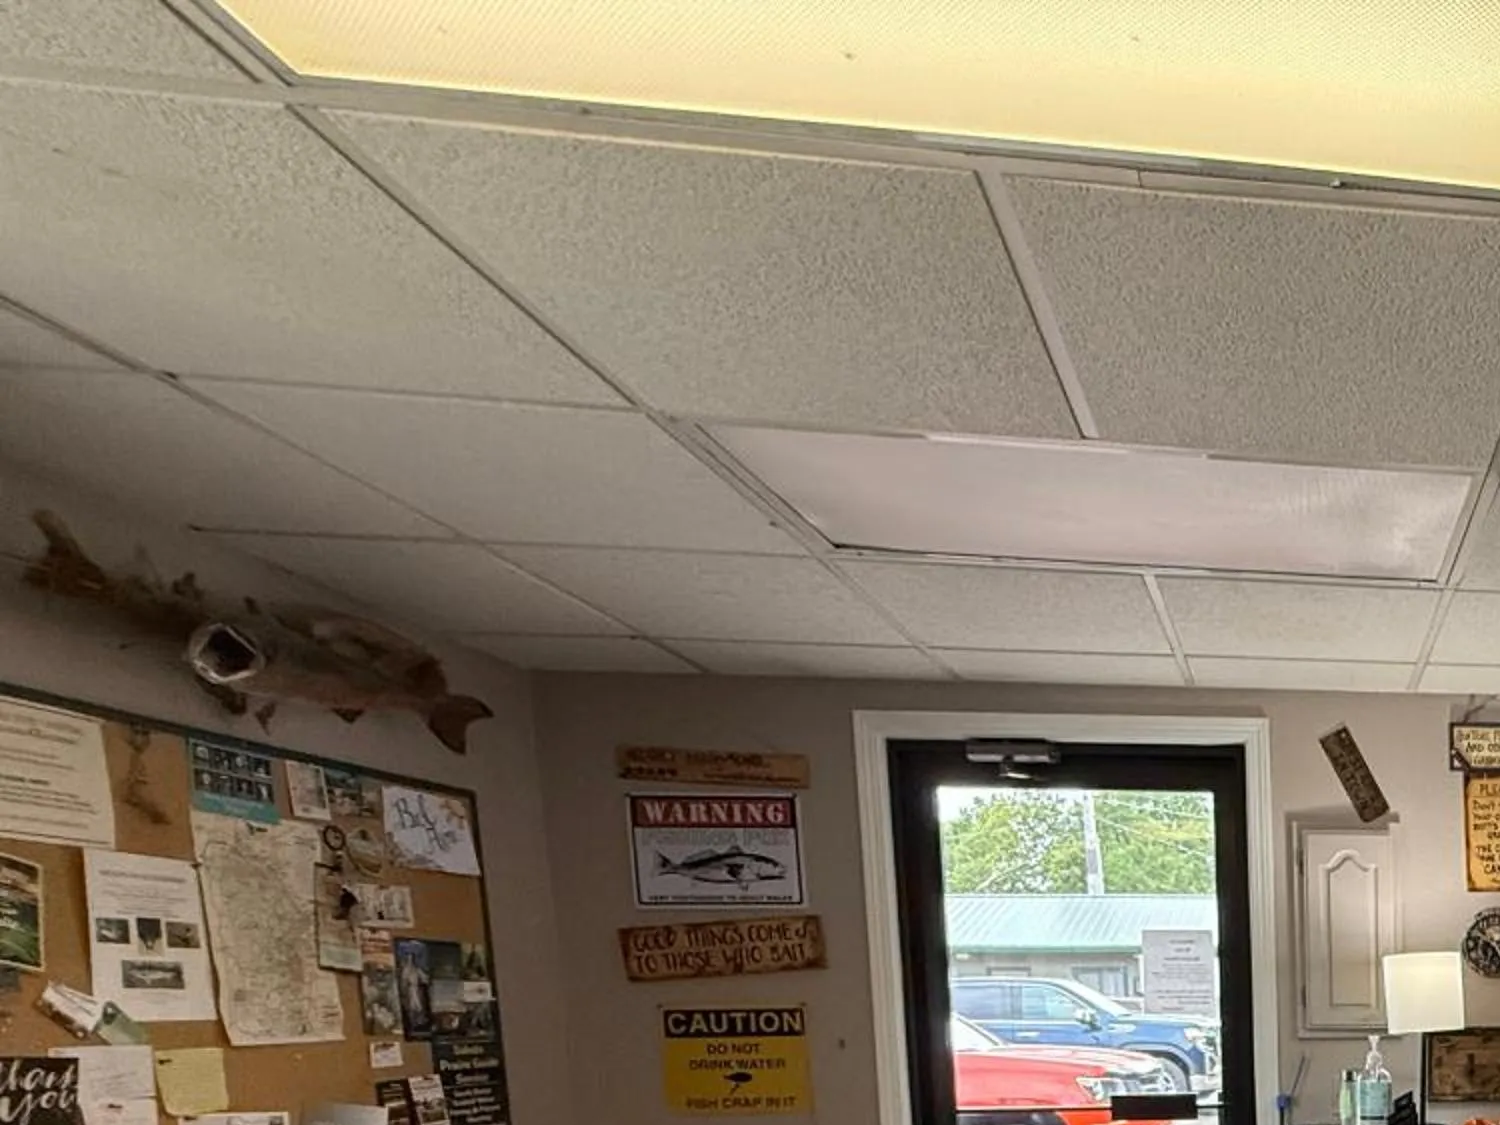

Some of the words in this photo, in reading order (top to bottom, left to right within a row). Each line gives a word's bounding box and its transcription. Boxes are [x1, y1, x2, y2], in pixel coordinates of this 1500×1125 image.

[642, 802, 785, 824] WARNING
[633, 926, 677, 953] GOOD
[685, 922, 742, 948] THINGS
[748, 922, 792, 942] COME
[634, 954, 657, 974] TO
[661, 951, 715, 973] THOSE
[721, 946, 762, 966] WHO
[769, 942, 807, 962] BAIT
[668, 1011, 801, 1034] CAUTION
[707, 1043, 727, 1055] DO
[732, 1042, 760, 1055] NOT
[689, 1059, 733, 1070] DRINK
[735, 1058, 785, 1070] WATER
